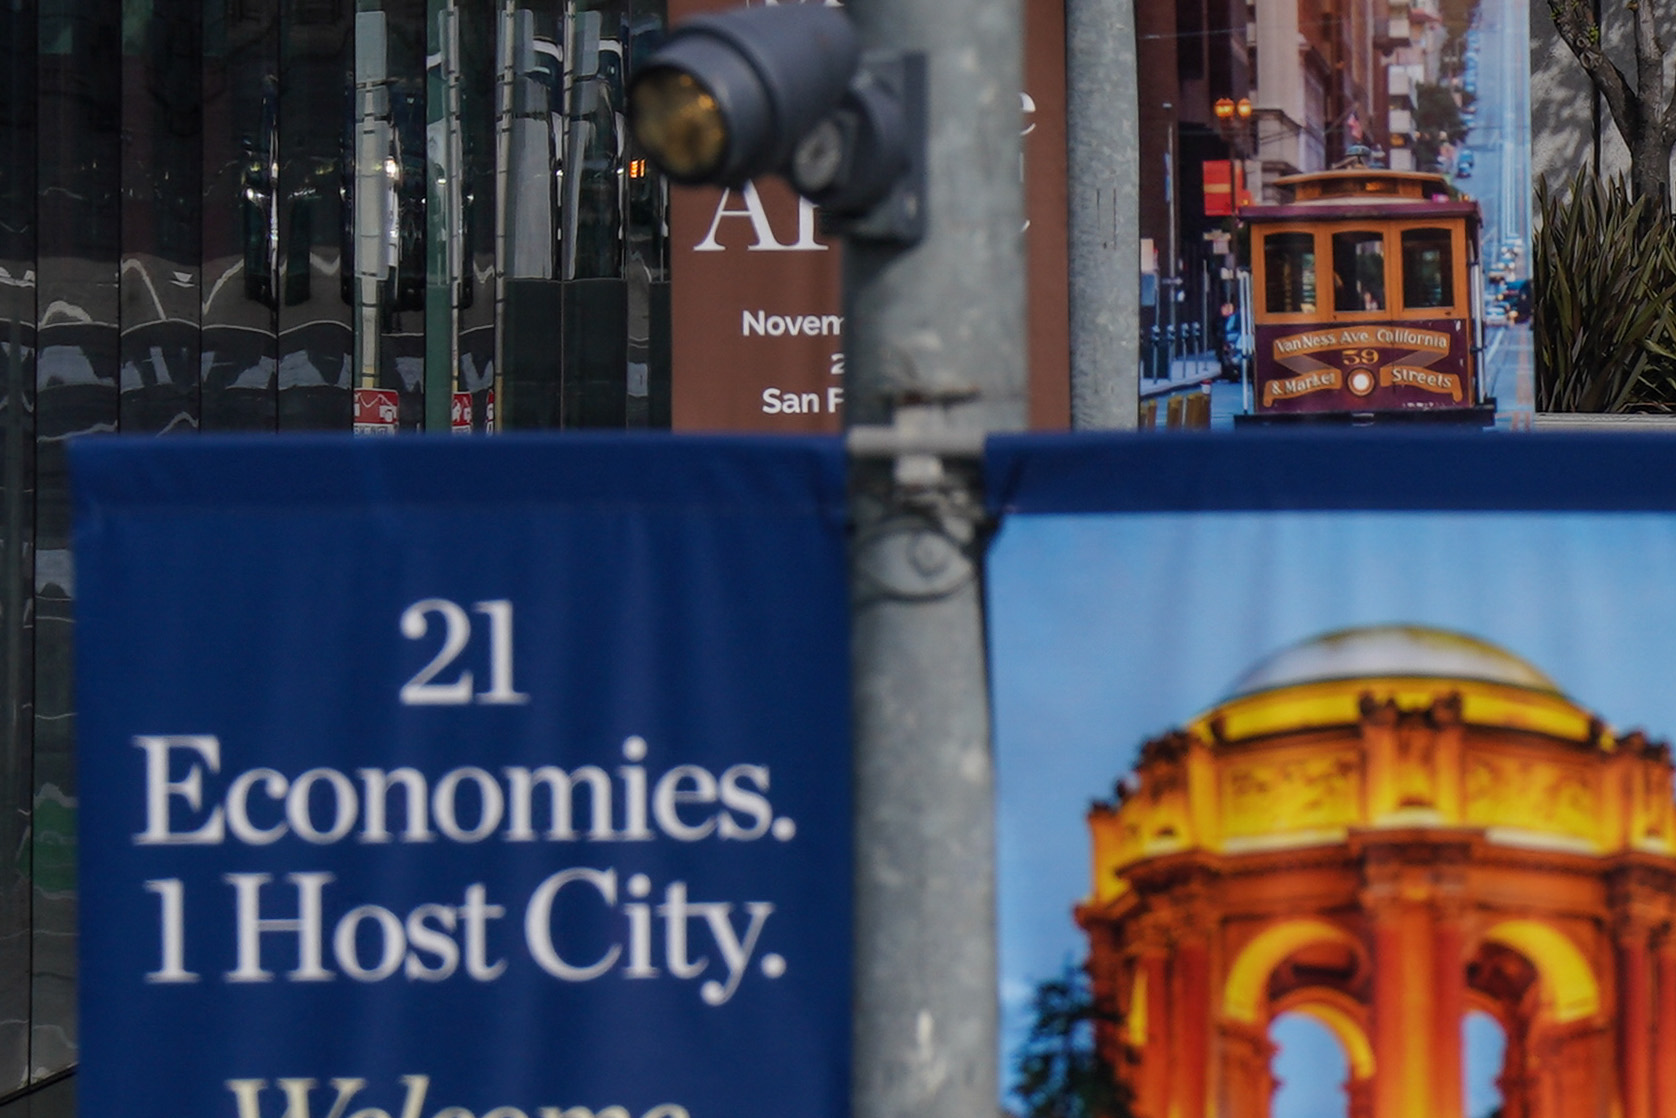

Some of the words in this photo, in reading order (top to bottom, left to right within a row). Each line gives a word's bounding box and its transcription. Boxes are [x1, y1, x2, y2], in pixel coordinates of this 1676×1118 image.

[1302, 333, 1336, 350] Ness
[1376, 328, 1447, 350] California
[1342, 349, 1379, 366] 59
[1271, 381, 1283, 396] &
[1285, 371, 1336, 393] Market
[1391, 367, 1453, 389] Streets
[762, 387, 820, 414] San
[401, 598, 529, 706] 21
[133, 735, 796, 845] Economies.
[145, 877, 200, 984] 1
[224, 873, 508, 983] Host
[525, 867, 788, 1006] City.
